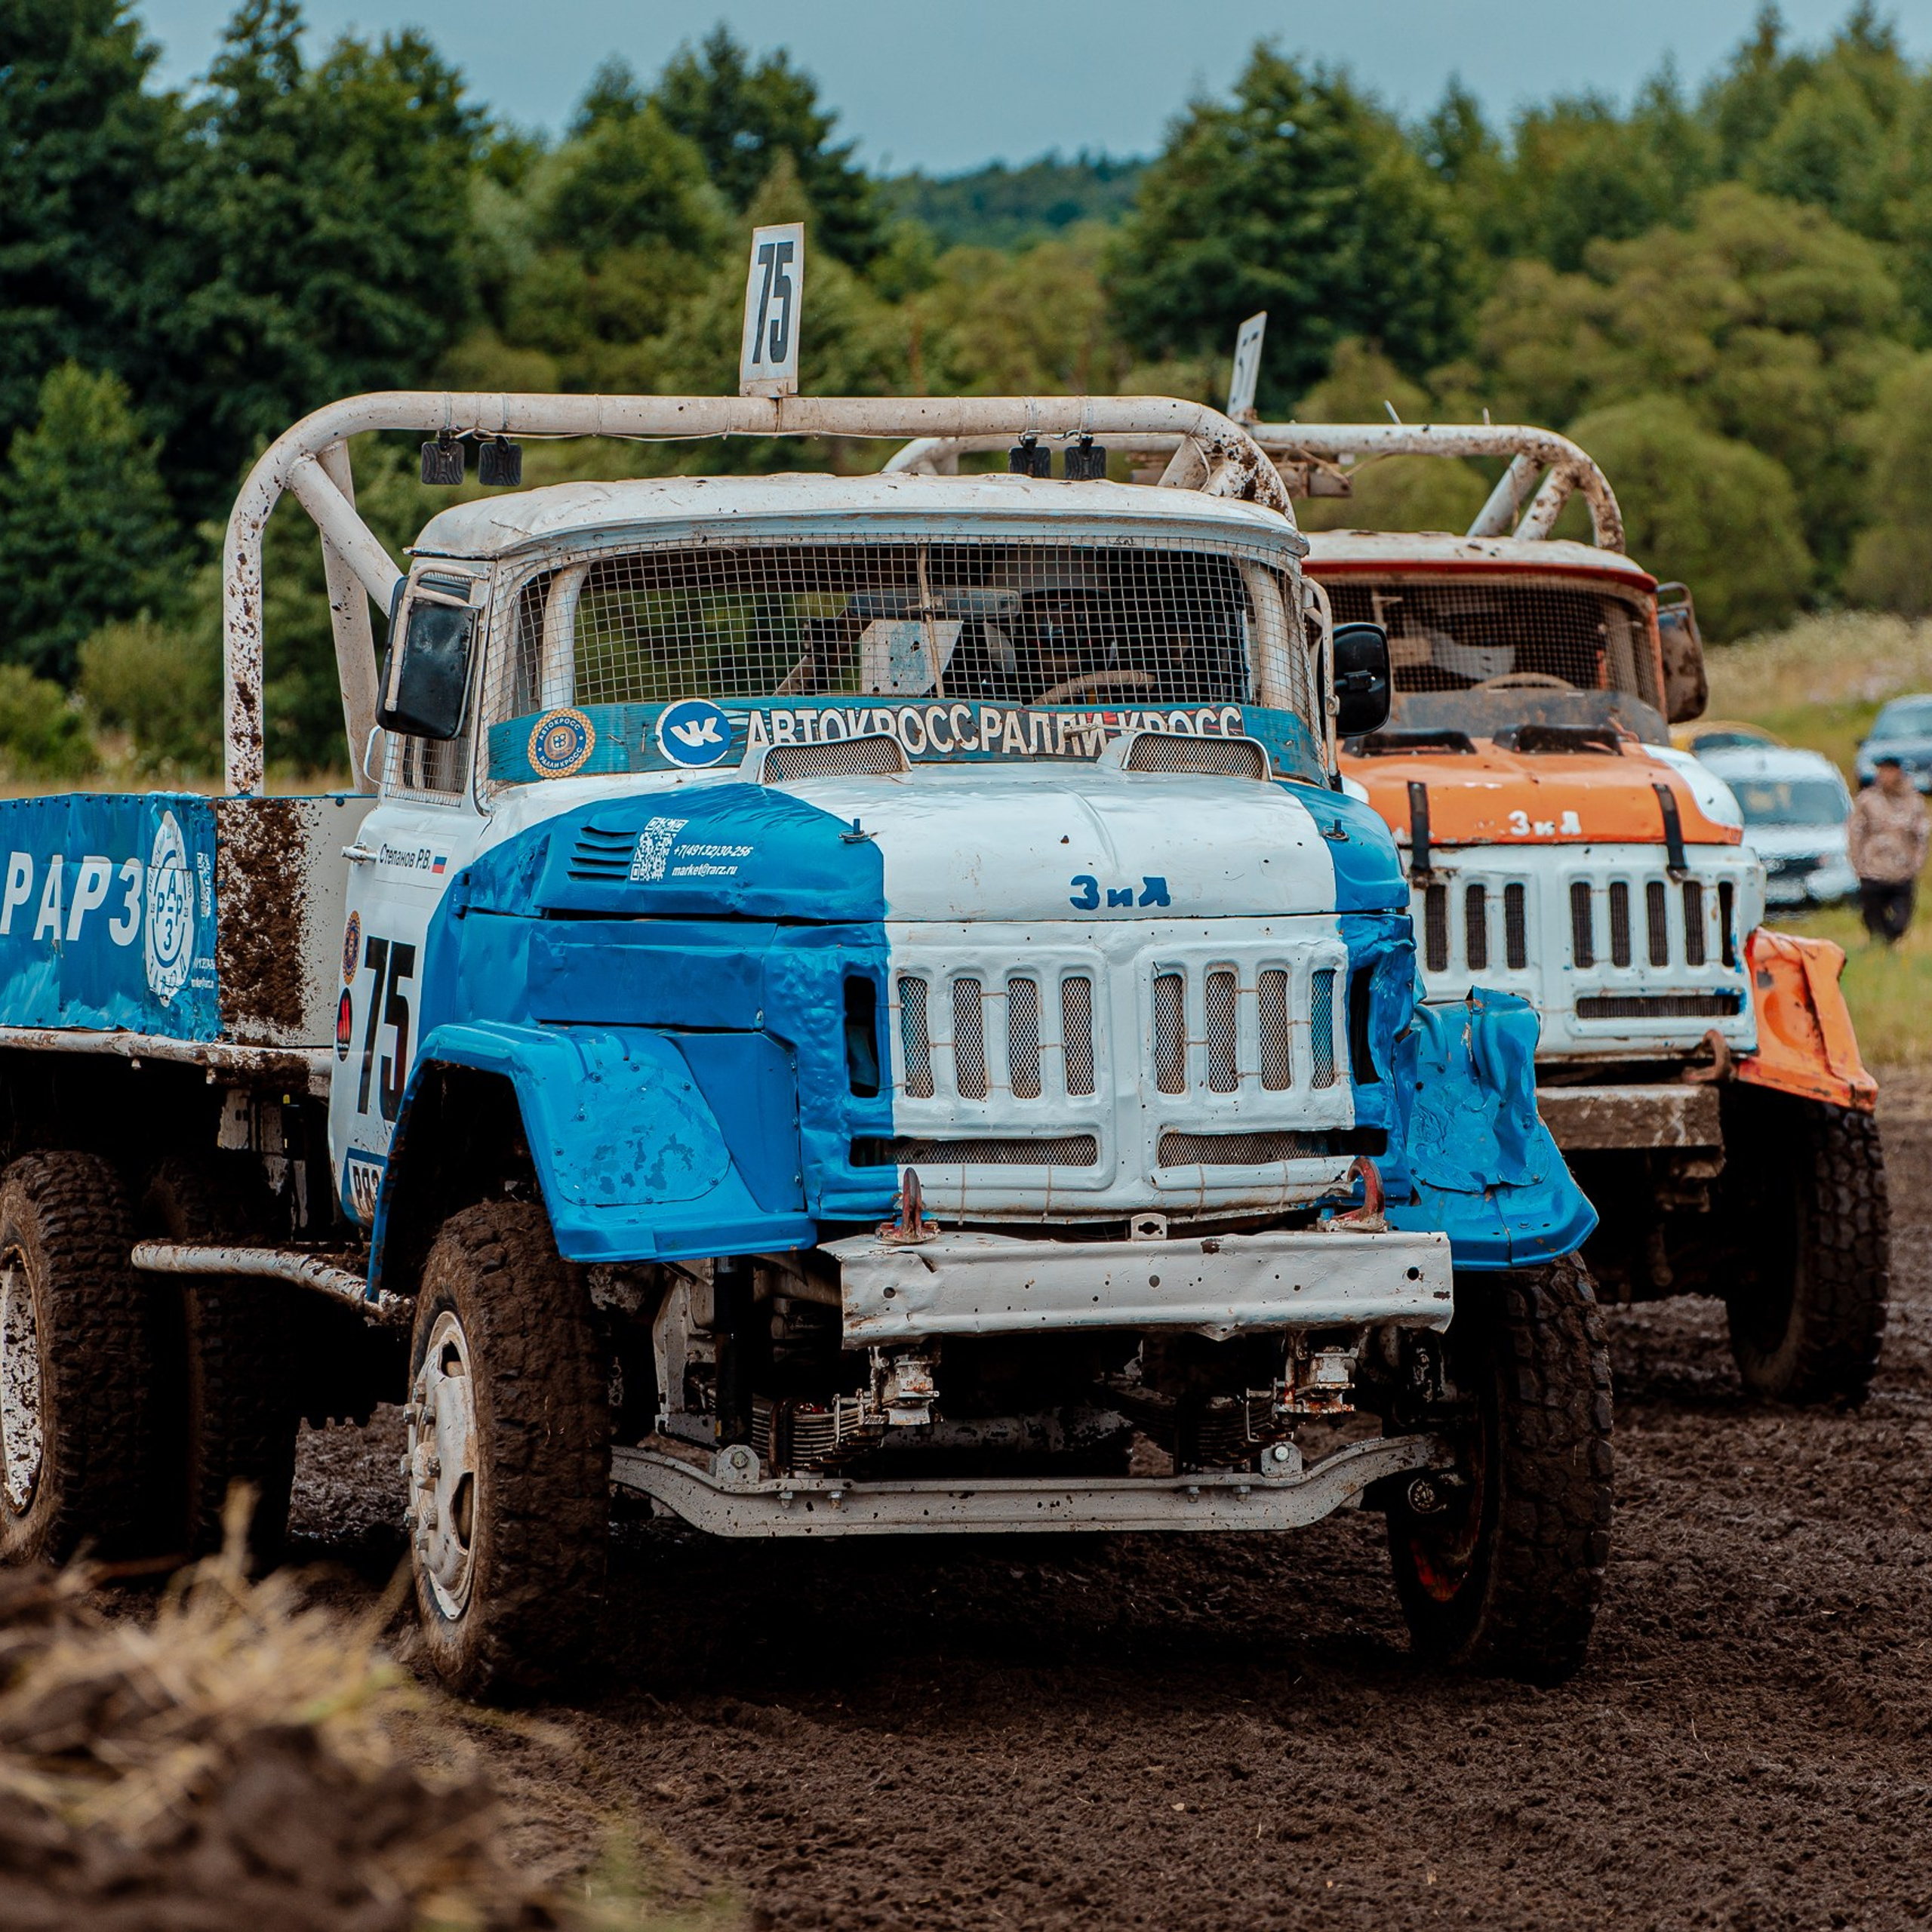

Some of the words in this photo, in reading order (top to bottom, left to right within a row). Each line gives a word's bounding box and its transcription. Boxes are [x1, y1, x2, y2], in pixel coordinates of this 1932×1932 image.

[752, 241, 794, 364] 75
[538, 718, 581, 740] АВТОКРОСС
[746, 703, 979, 755] АВТОКРОСС
[380, 843, 416, 868] Степанов
[415, 848, 431, 870] Р.В.
[672, 863, 738, 877] market@rarz.ru
[0, 851, 143, 946] РАРЗ
[357, 935, 417, 1123] 75
